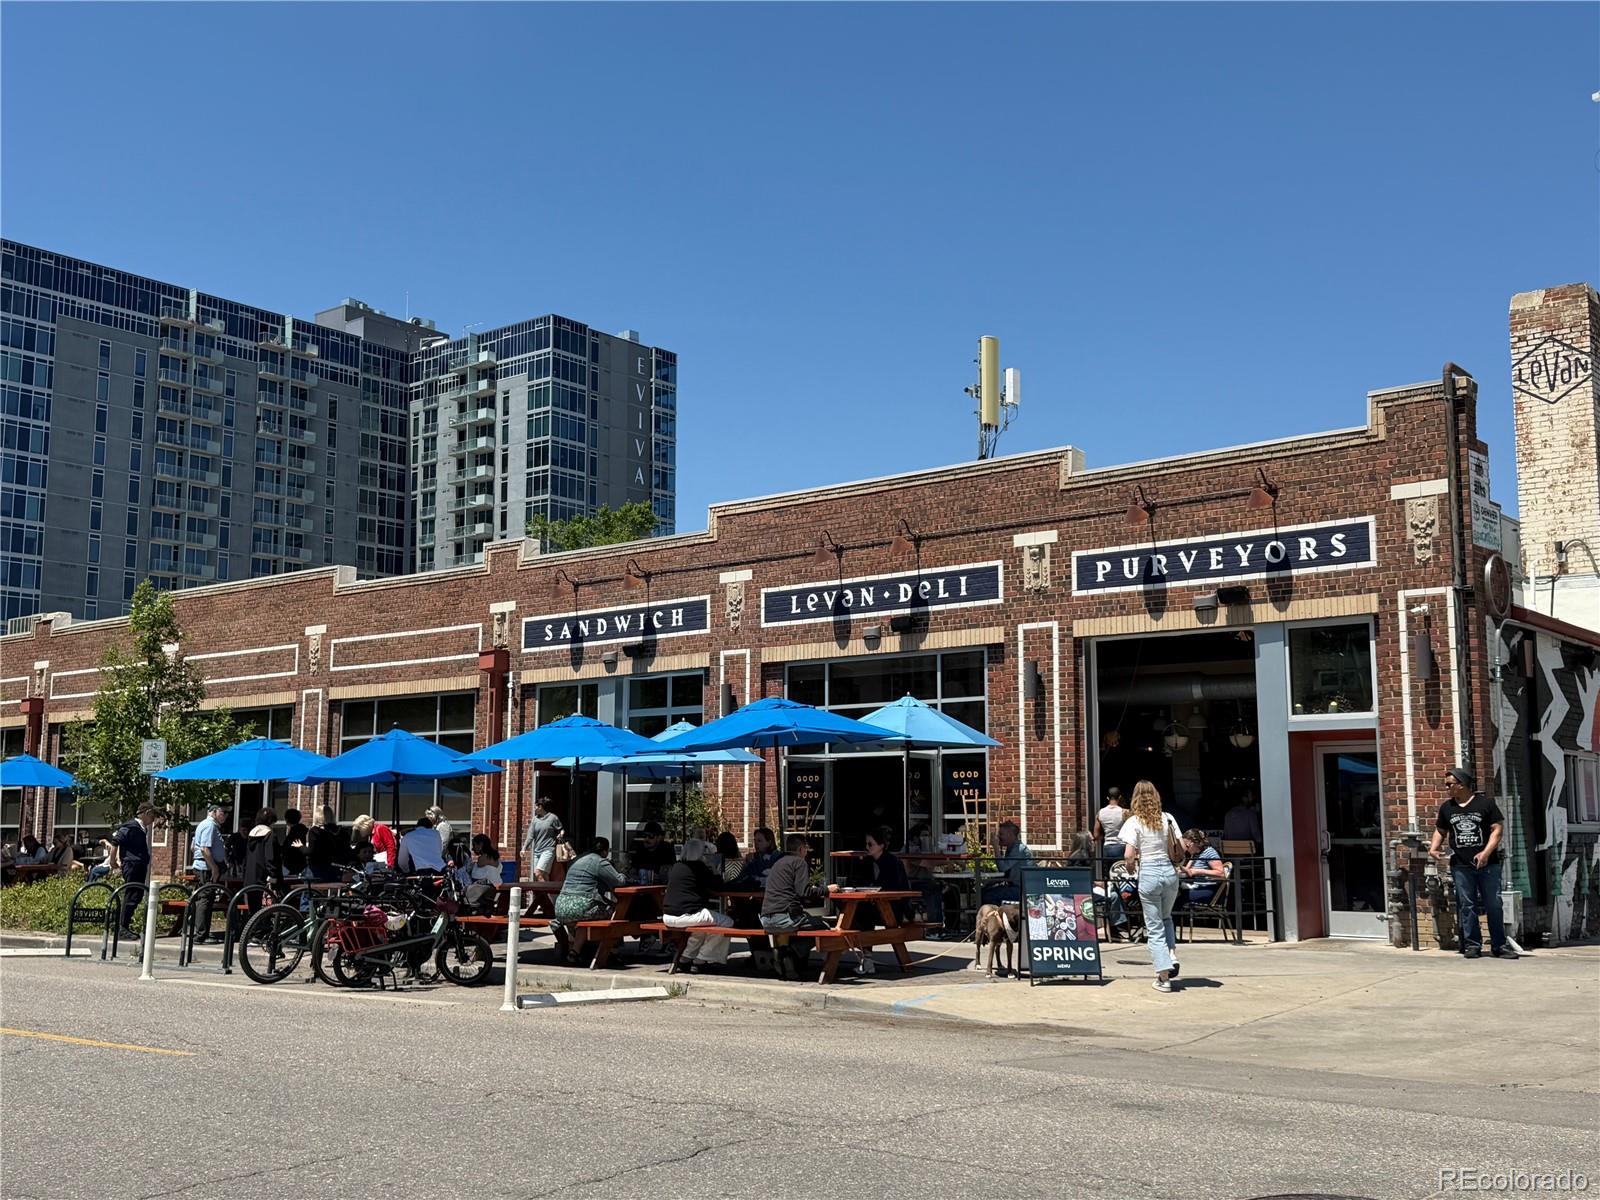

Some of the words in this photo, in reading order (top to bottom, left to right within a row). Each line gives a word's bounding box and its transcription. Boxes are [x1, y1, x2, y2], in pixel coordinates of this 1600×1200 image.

[634, 357, 647, 486] EVIVA
[1095, 532, 1347, 583] PURVEYORS
[544, 608, 684, 641] SANDWICH
[796, 775, 820, 783] GOOD
[952, 771, 979, 779] GOOD
[953, 789, 979, 797] VIBES
[1033, 946, 1096, 961] SPRING
